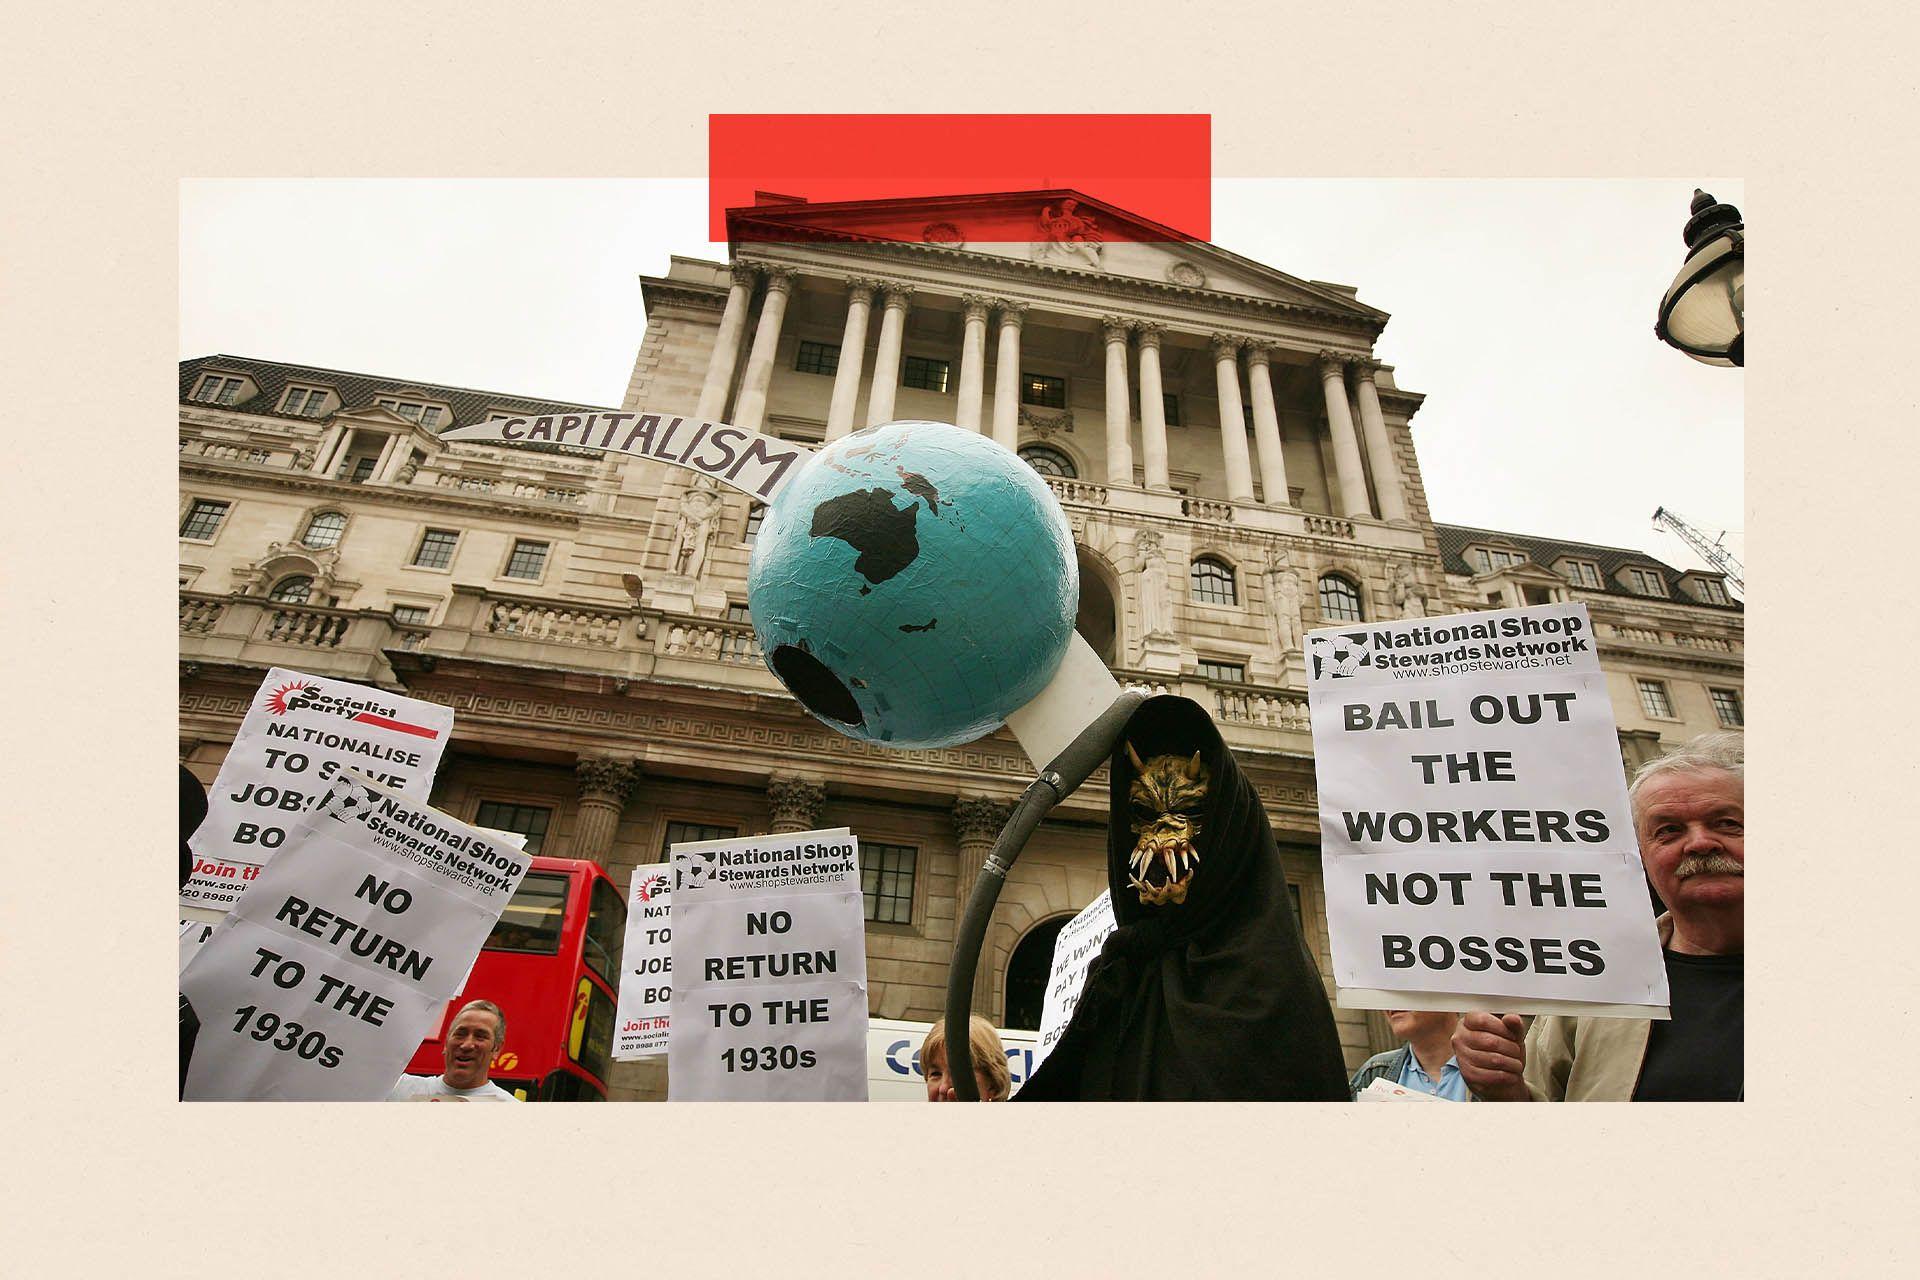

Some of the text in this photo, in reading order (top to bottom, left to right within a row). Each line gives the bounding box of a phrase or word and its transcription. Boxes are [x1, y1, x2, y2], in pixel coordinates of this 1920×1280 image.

[501, 413, 799, 498] CAPITALISM
[1374, 615, 1582, 651] National Shop
[1375, 636, 1589, 670] Stewards Network
[1393, 653, 1572, 680] www.shopstewards.net
[287, 697, 359, 720] Party
[300, 686, 397, 718] Socialist
[1343, 692, 1577, 731] BAIL OUT
[266, 722, 421, 768] NATIONALISE
[265, 748, 407, 790] TO SVE
[1411, 751, 1516, 785] THE
[233, 822, 286, 848] BO
[378, 798, 522, 878] National Shop
[1341, 810, 1611, 844] WORKERS
[192, 859, 237, 879] Join
[367, 816, 513, 893] Stewards Network
[373, 834, 496, 897] www.shopstewards.net
[719, 843, 853, 867] National Shop
[719, 860, 855, 882] Stewards Network
[729, 873, 845, 890] www.shopstewards.net
[202, 891, 234, 903] 8988
[354, 873, 413, 915] NO
[1365, 872, 1607, 908] NOT THE
[644, 905, 671, 919] NAT
[747, 911, 792, 936] NO
[275, 895, 433, 982] RETURN
[646, 928, 671, 946] TO
[704, 950, 837, 982] RETURN
[1055, 954, 1071, 977] WE
[1381, 934, 1606, 976] BOSSES
[249, 946, 395, 1028] TO THE
[644, 986, 672, 1004] BO
[1054, 971, 1077, 999] PAY
[623, 1020, 650, 1031] Join
[708, 998, 829, 1028] TO THE
[231, 1004, 344, 1070] 1930s
[721, 1045, 817, 1073] 1930s
